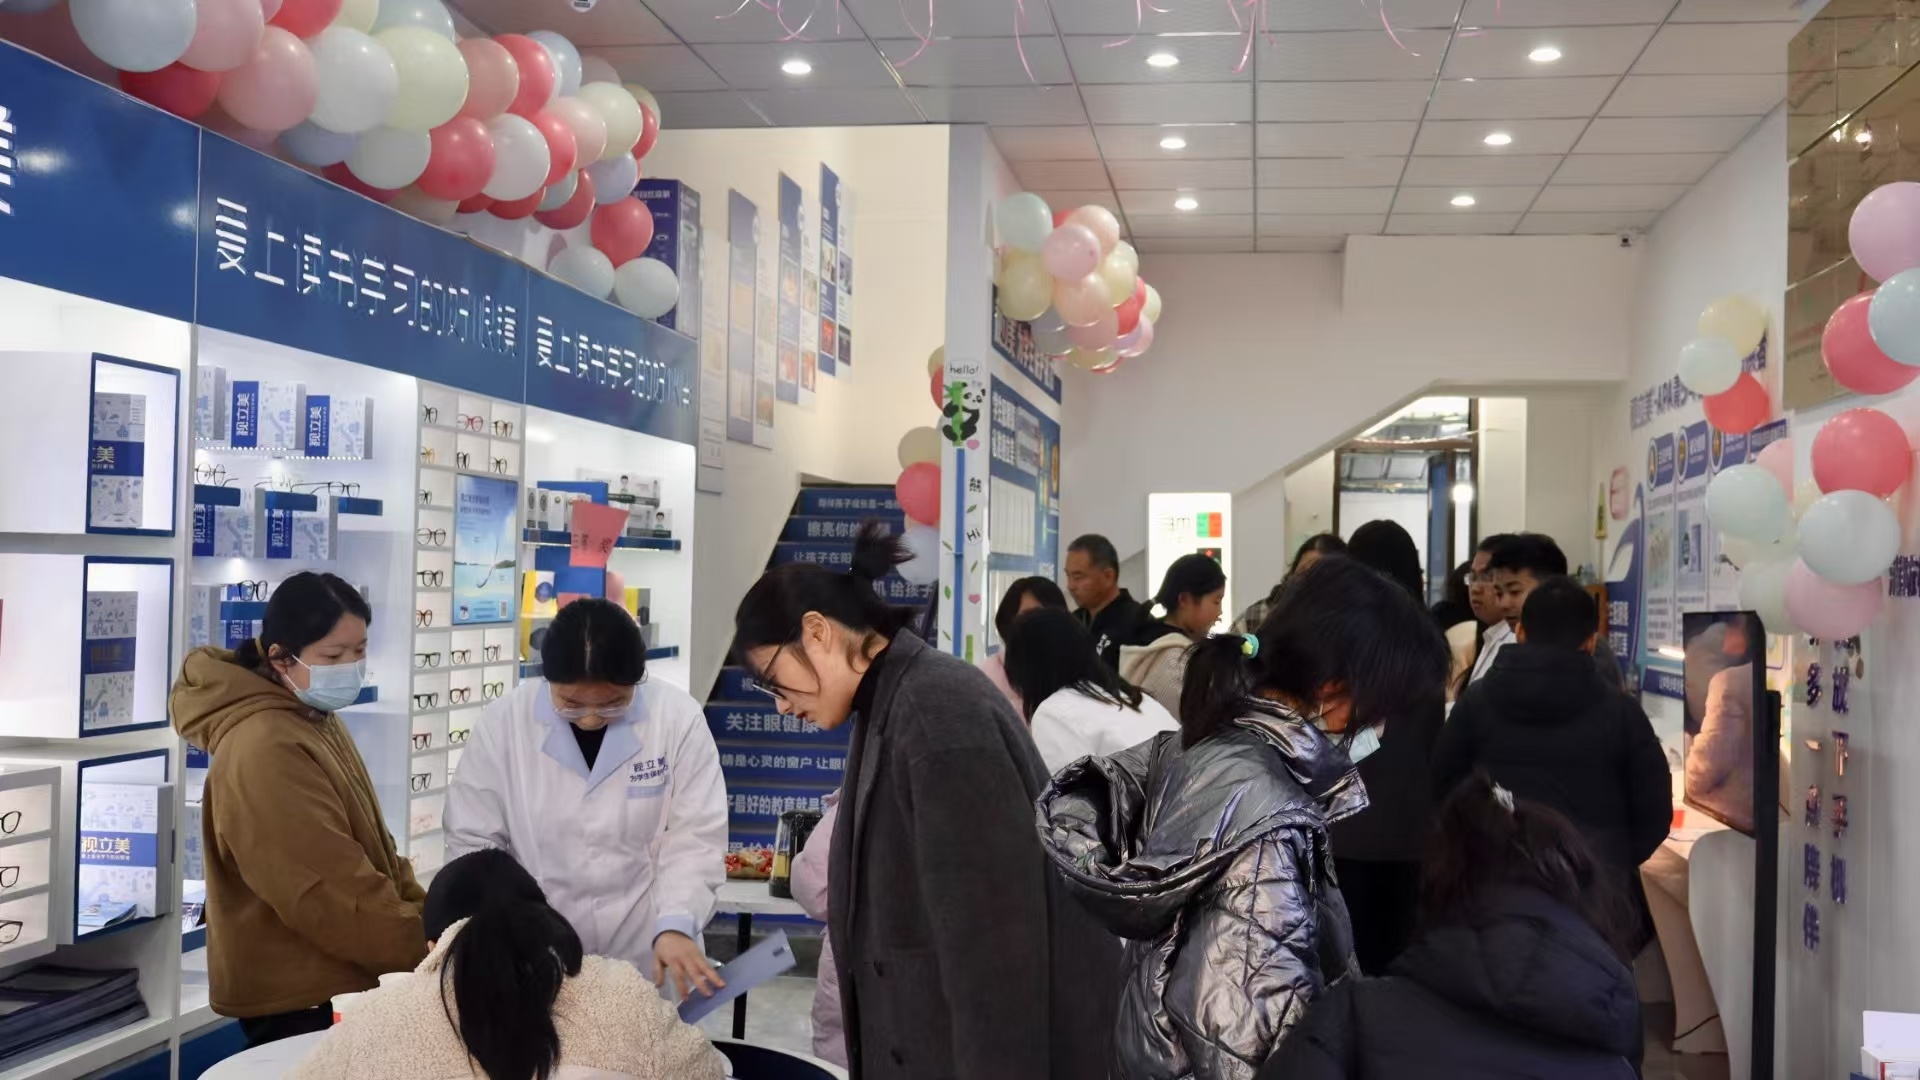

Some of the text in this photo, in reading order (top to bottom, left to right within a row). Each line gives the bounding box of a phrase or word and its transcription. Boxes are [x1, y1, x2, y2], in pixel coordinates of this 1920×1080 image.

[949, 362, 979, 375] hello!
[236, 392, 250, 436] 视立美
[309, 406, 322, 447] 视立美
[966, 528, 981, 541] Hi
[726, 713, 820, 734] 关注眼健康
[816, 756, 847, 770] 让眼
[81, 836, 131, 854] 视立美
